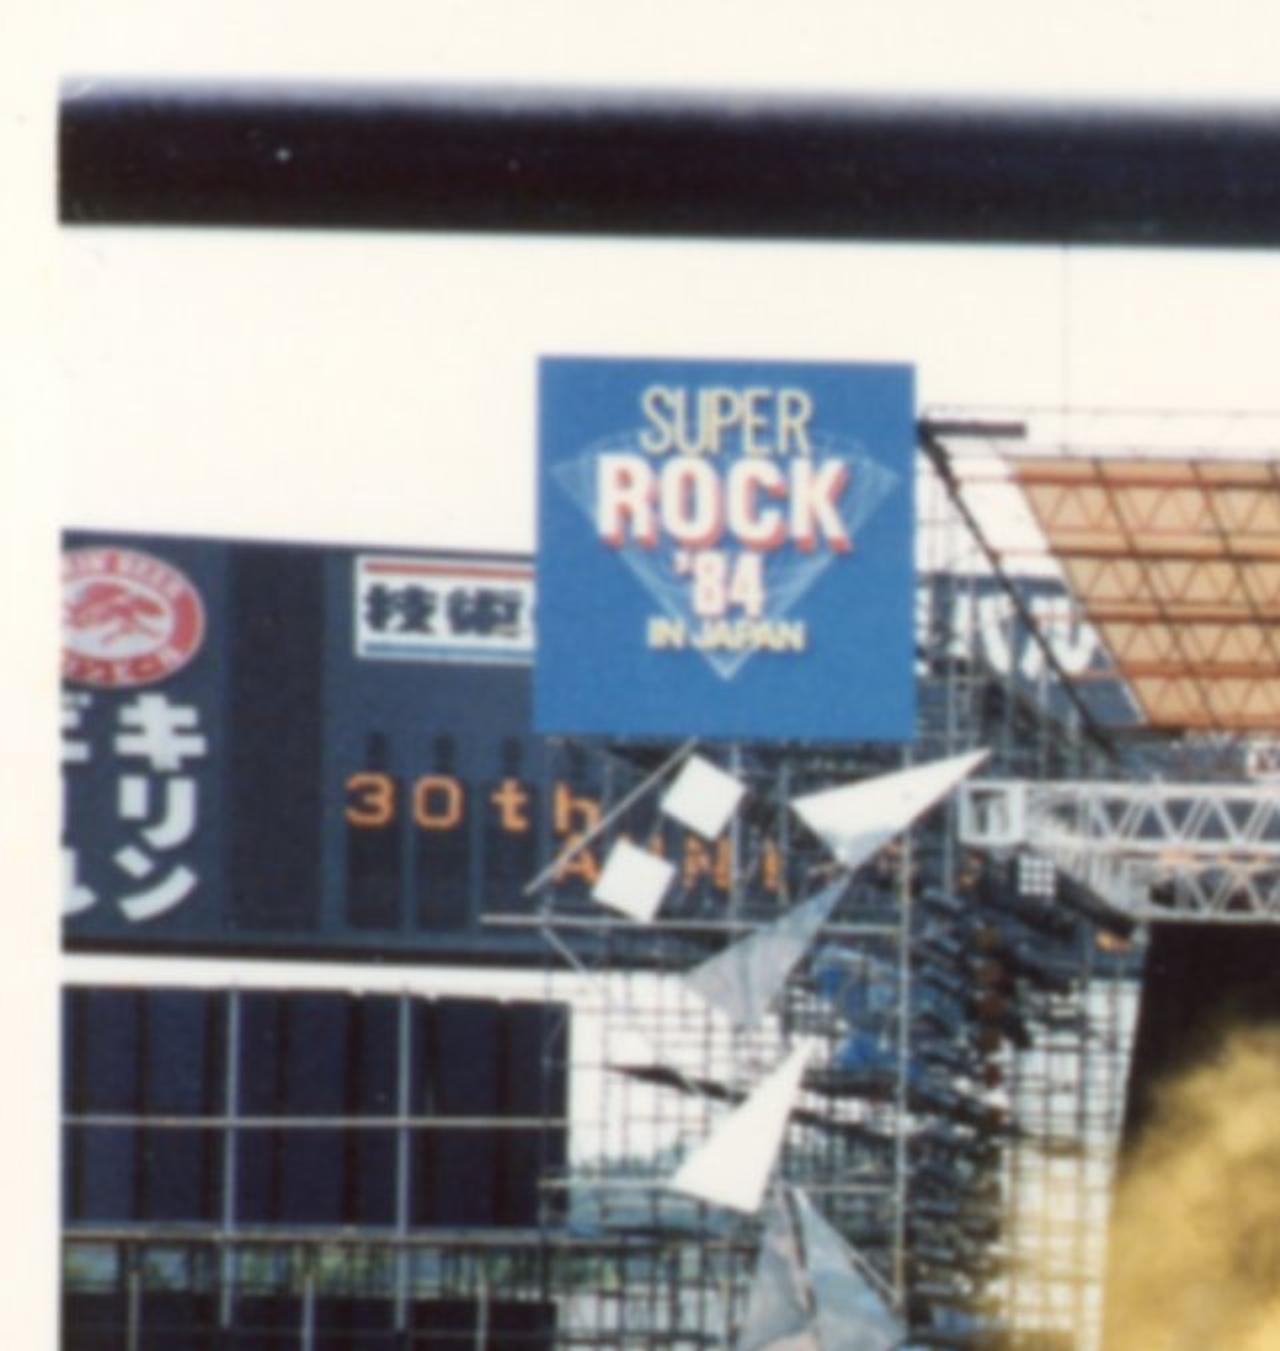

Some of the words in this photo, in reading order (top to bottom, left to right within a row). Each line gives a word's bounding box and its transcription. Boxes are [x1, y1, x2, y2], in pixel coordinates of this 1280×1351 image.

[639, 385, 814, 456] SUPER
[596, 455, 852, 552] ROCK
[674, 550, 766, 618] '84
[647, 618, 685, 650] IN
[692, 619, 807, 651] JAPAN
[114, 694, 208, 923] キリン
